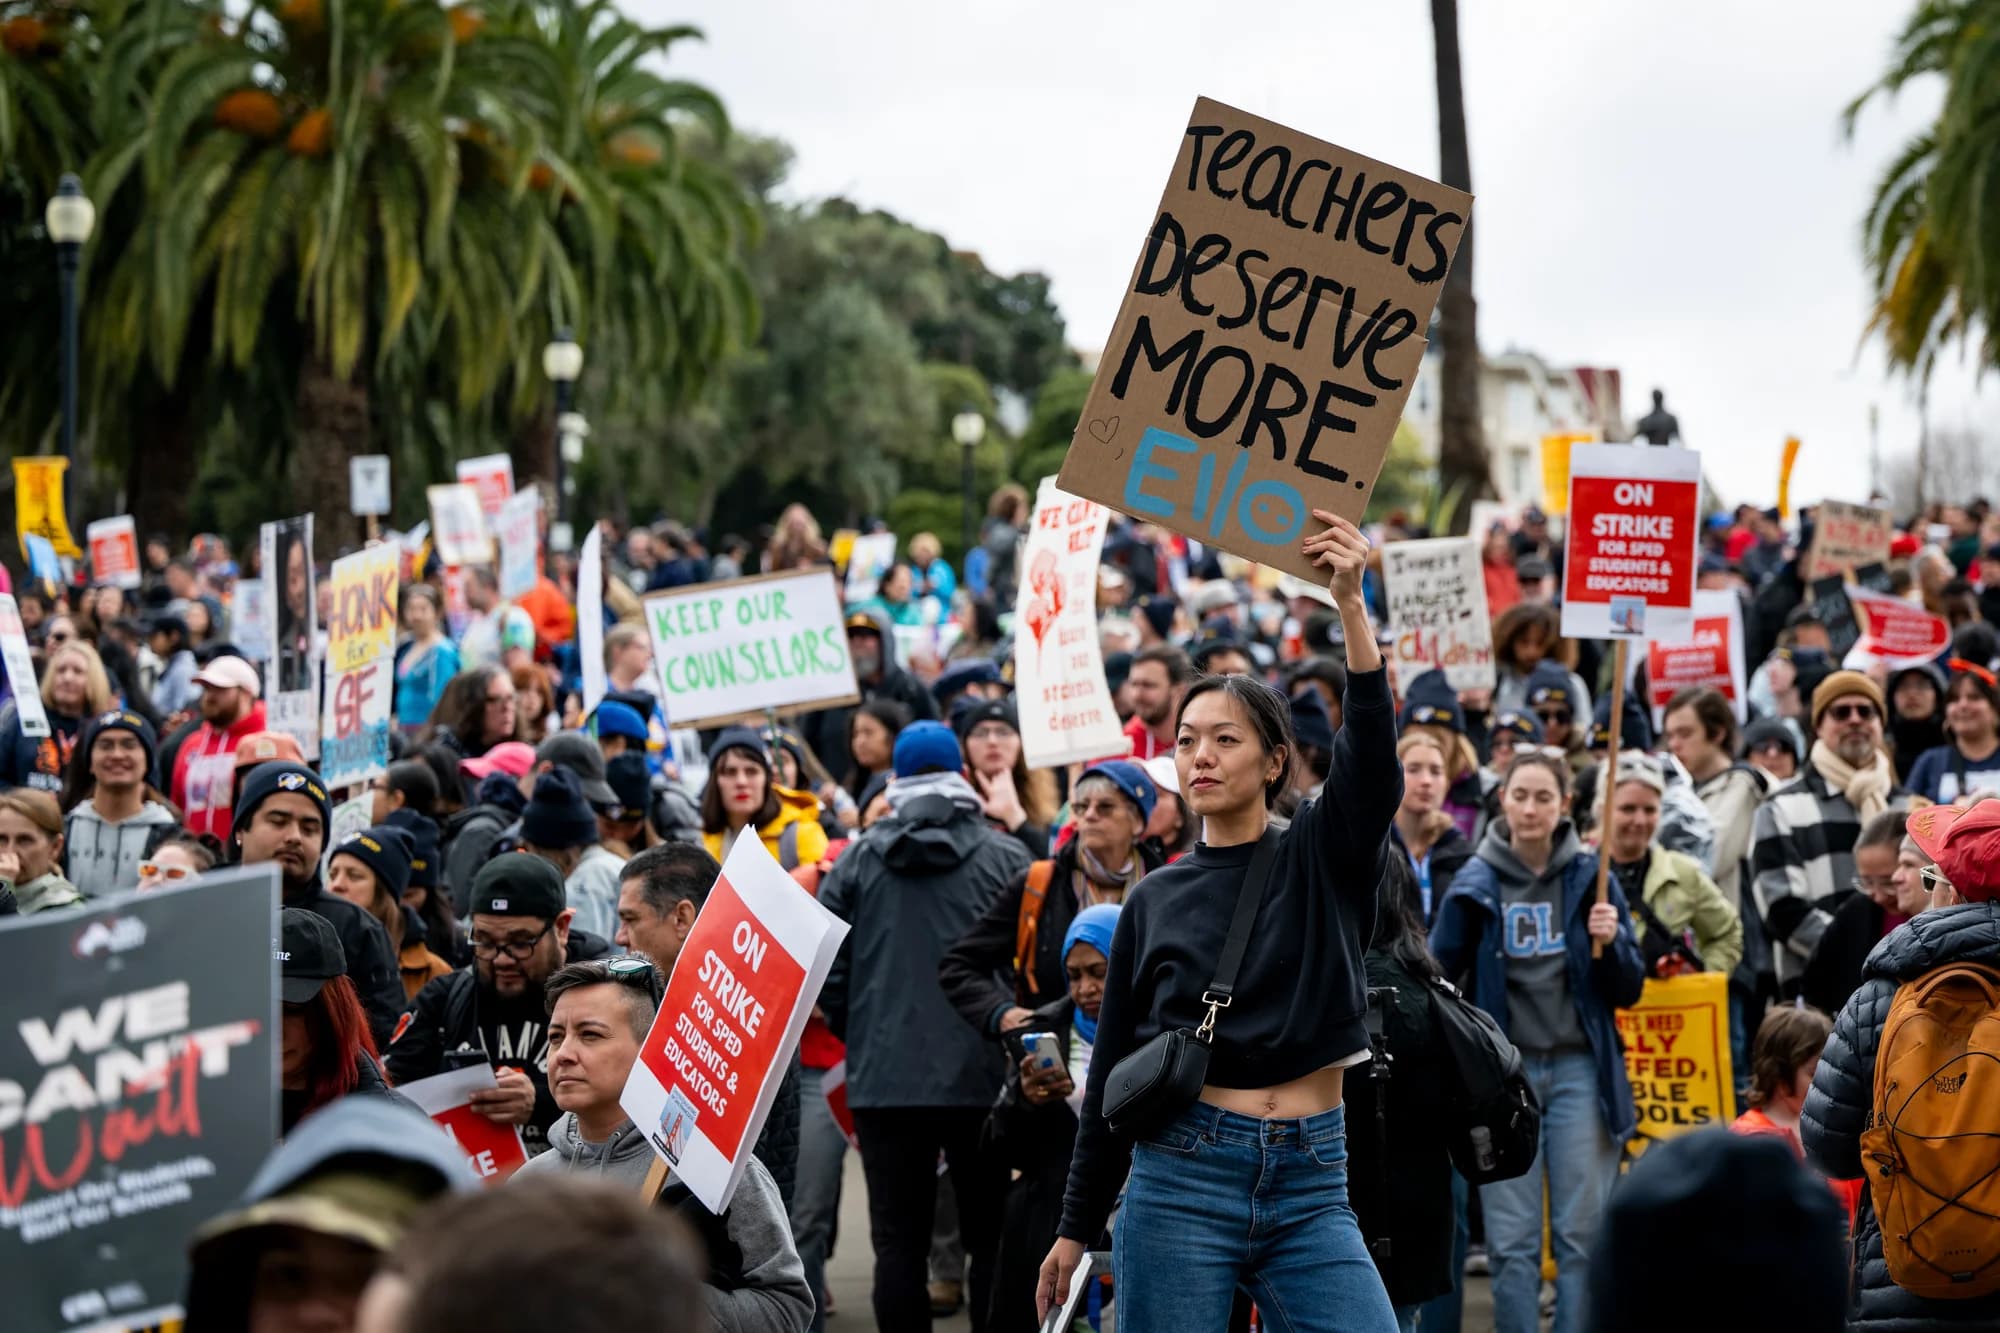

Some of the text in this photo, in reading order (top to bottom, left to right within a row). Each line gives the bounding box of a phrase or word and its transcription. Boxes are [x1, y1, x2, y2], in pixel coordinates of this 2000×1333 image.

[1110, 315, 1377, 489] MORE.
[1591, 512, 1674, 540] STRIKE
[1613, 482, 1655, 507] ON
[1588, 557, 1673, 577] STUDENTS &
[1598, 540, 1665, 557] FOR SPED
[328, 570, 397, 642] HONK
[655, 590, 793, 641] KEEP OUR
[1585, 574, 1670, 594] EDUCATORS
[665, 624, 847, 694] COUNSELORS
[334, 663, 378, 741] SF
[732, 919, 768, 974] ON
[19, 980, 190, 1066] WE
[690, 991, 742, 1058] FOR SPED
[697, 948, 766, 1039] STRIKE
[1646, 1013, 1684, 1032] NEED
[662, 1035, 729, 1119] EDUCATORS
[675, 1011, 728, 1083] STUDENTS
[726, 1070, 739, 1095] &
